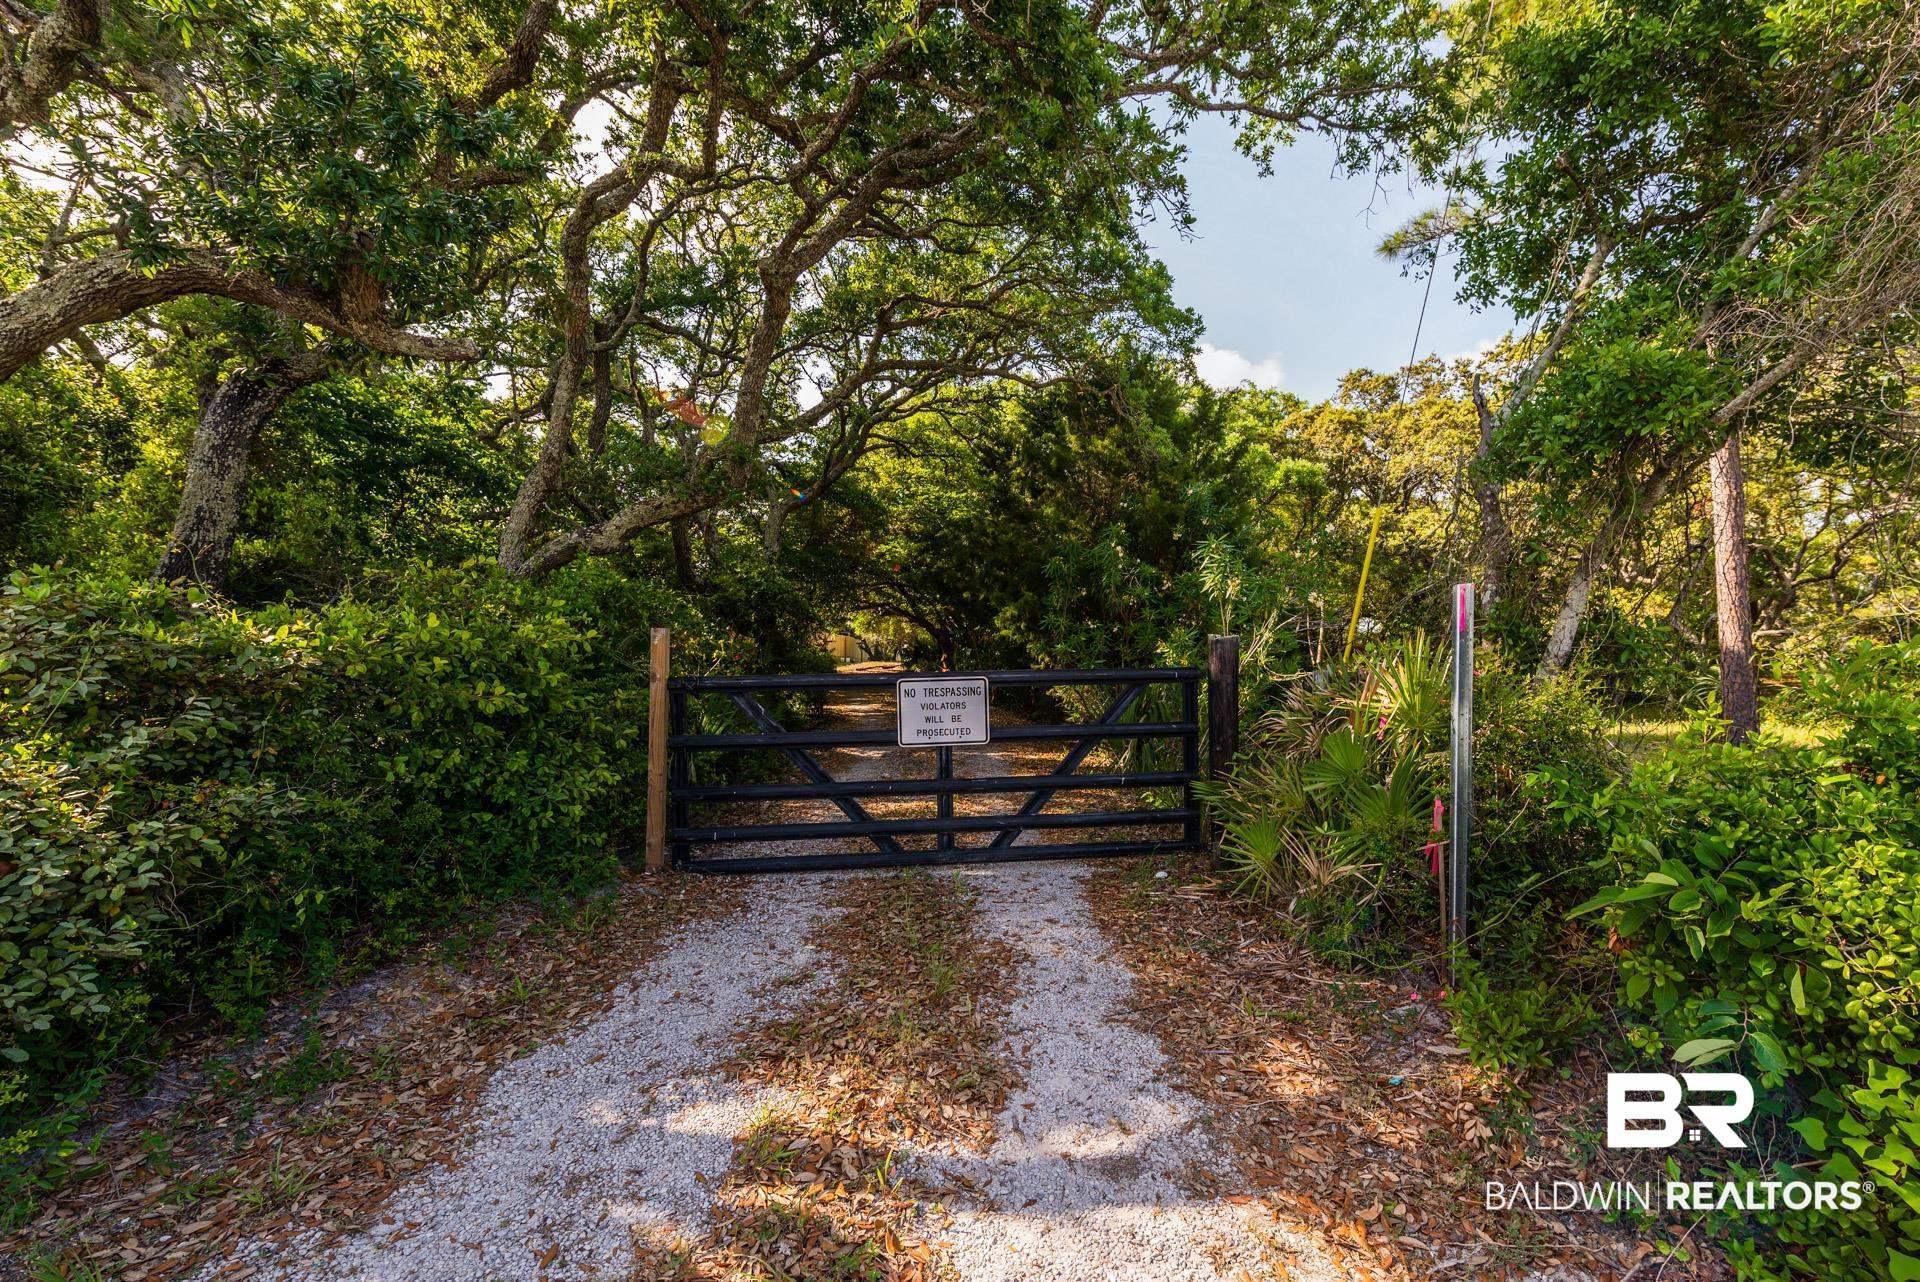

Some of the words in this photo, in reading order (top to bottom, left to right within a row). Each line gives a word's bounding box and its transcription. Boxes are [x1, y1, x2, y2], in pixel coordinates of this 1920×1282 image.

[904, 688, 916, 698] NO
[923, 686, 982, 698] TRESPASSING
[920, 701, 967, 711] VIOLATORS
[924, 715, 944, 724] WILL
[951, 714, 962, 723] BE
[916, 727, 972, 737] PROSECUTED
